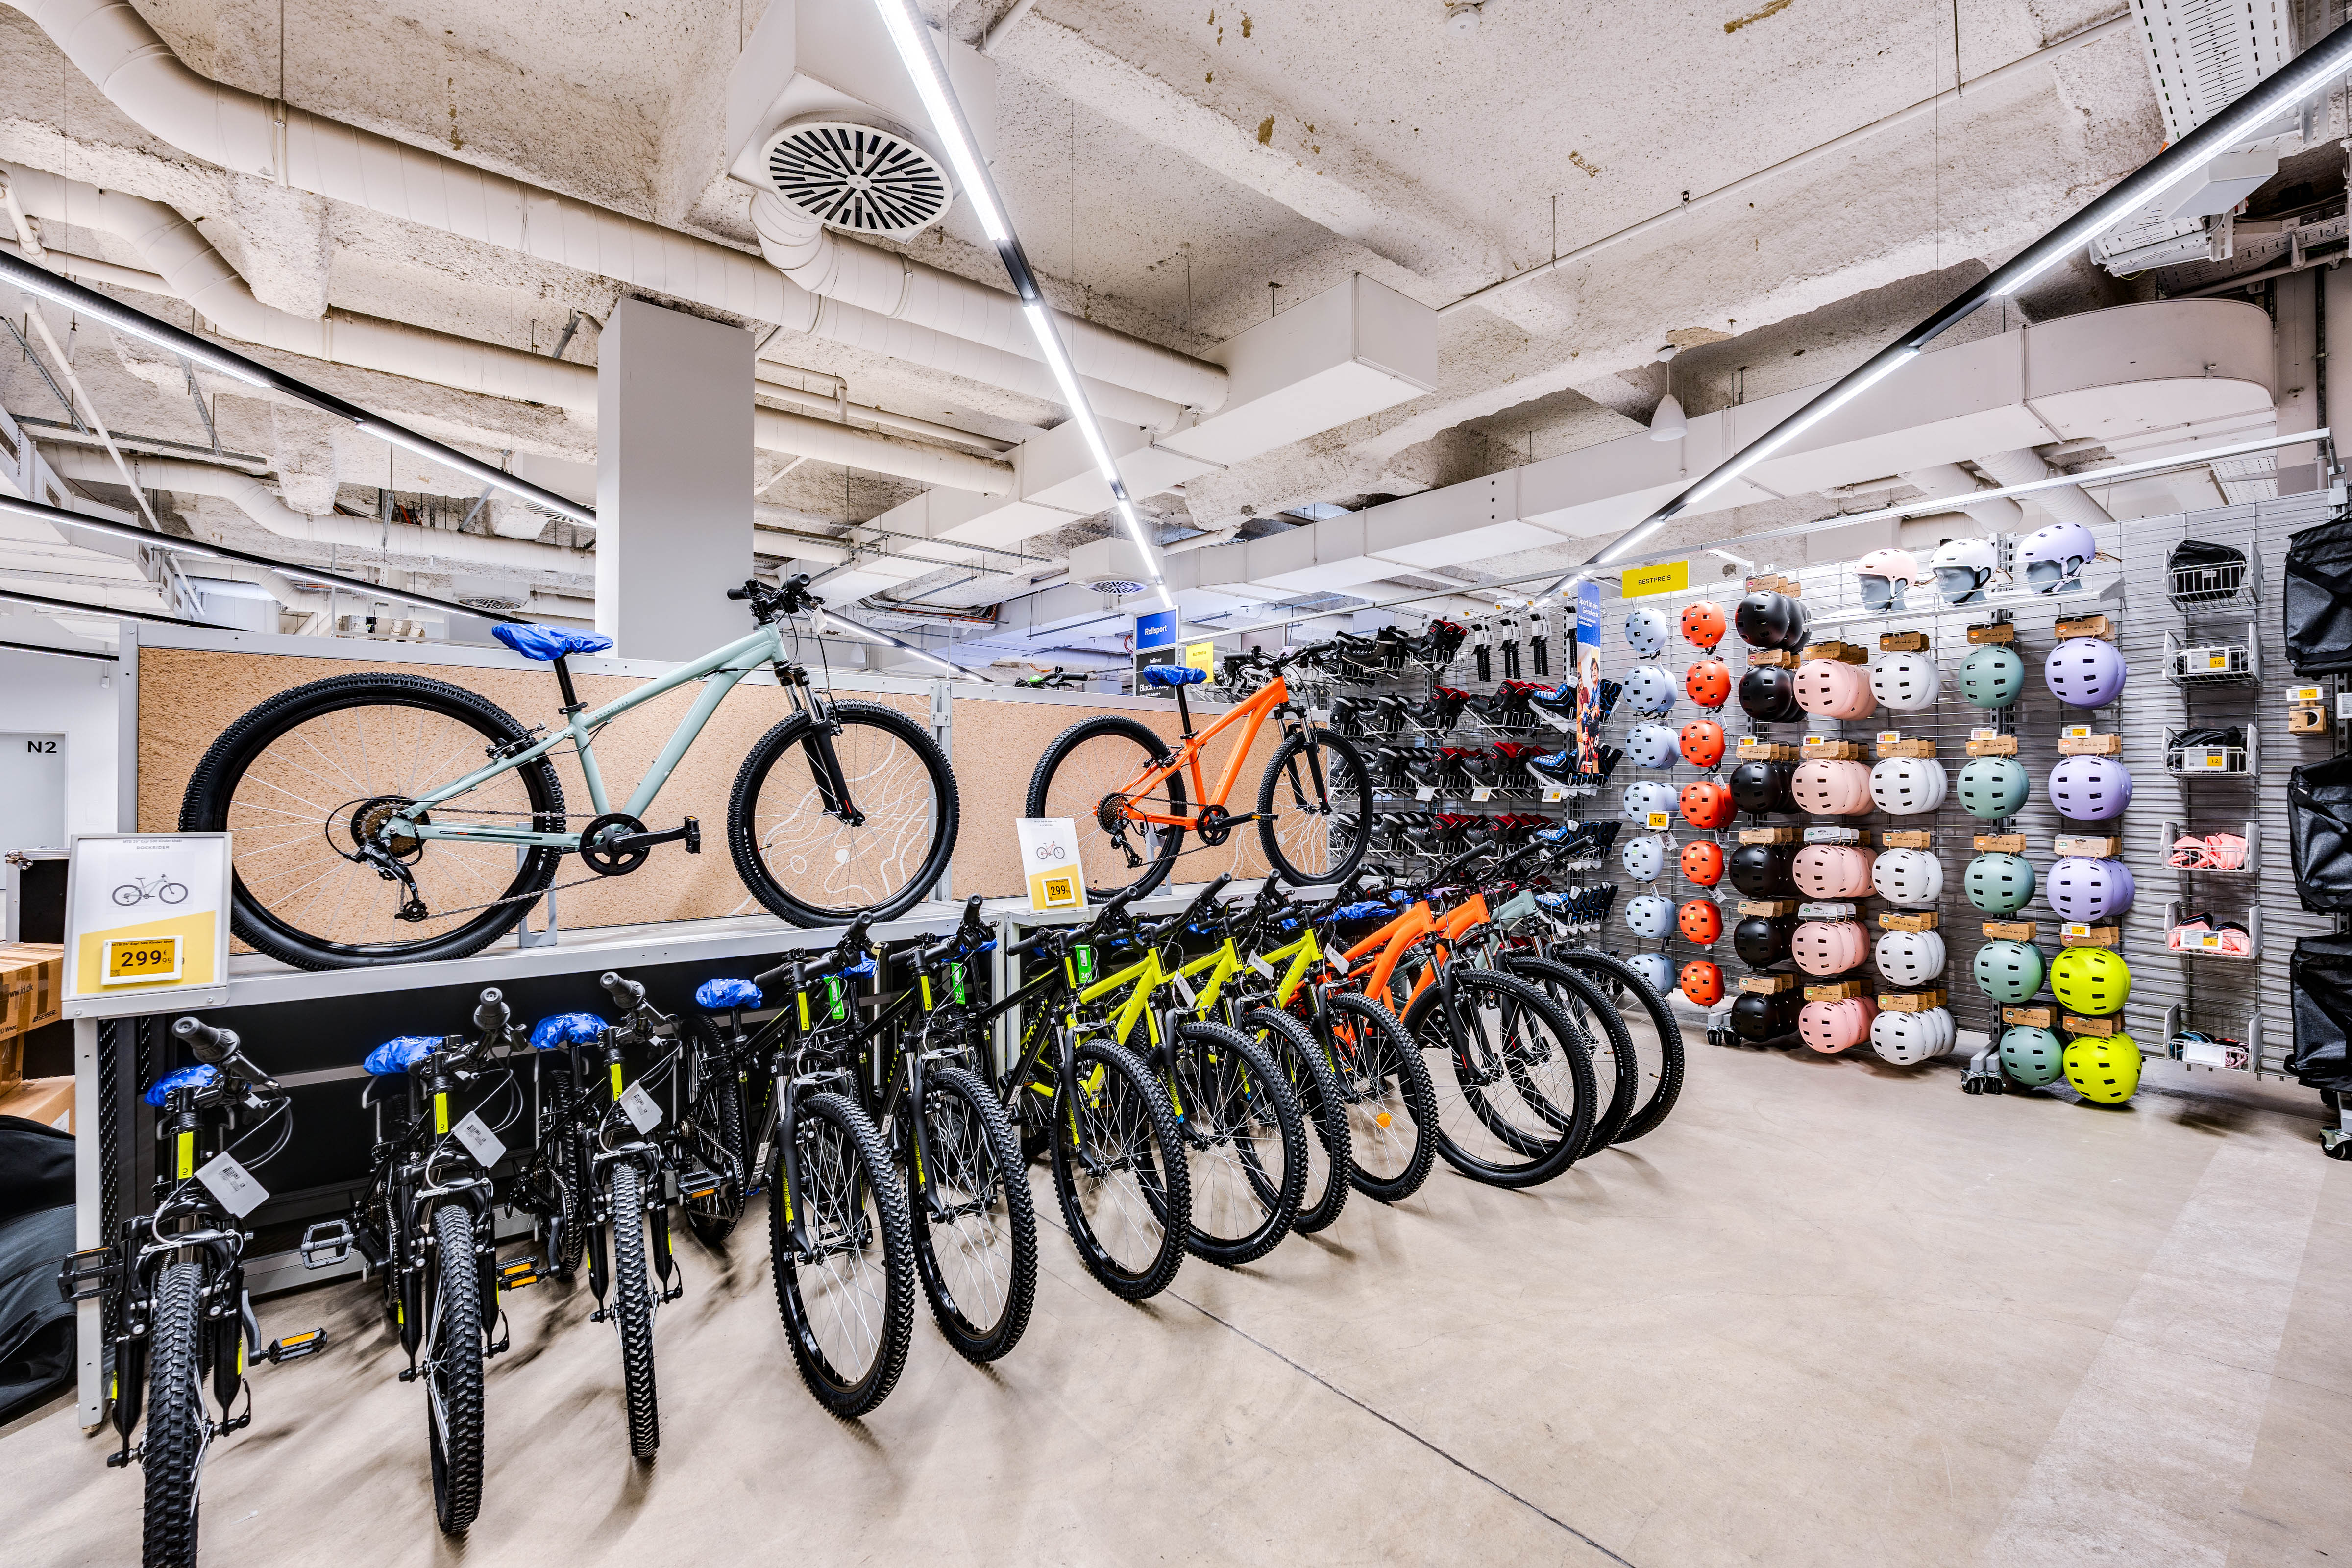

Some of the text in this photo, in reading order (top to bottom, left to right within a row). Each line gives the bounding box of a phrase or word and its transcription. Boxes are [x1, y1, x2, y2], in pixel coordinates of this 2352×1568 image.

[1638, 575, 1671, 585] BESTPREIS
[1579, 597, 1588, 606] Sport
[1582, 607, 1599, 618] Geschenk
[1145, 625, 1167, 635] Rollsport
[1139, 684, 1153, 692] Black
[595, 701, 628, 718] ROCKRIDER
[27, 740, 57, 754] N2
[744, 839, 761, 877] ROCKRIDER
[1051, 885, 1065, 895] 299
[121, 950, 162, 967] 299
[1473, 980, 1507, 989] ROCKRIDER
[1022, 999, 1049, 1055] ROCKRIDER
[410, 1152, 421, 1160] 20
